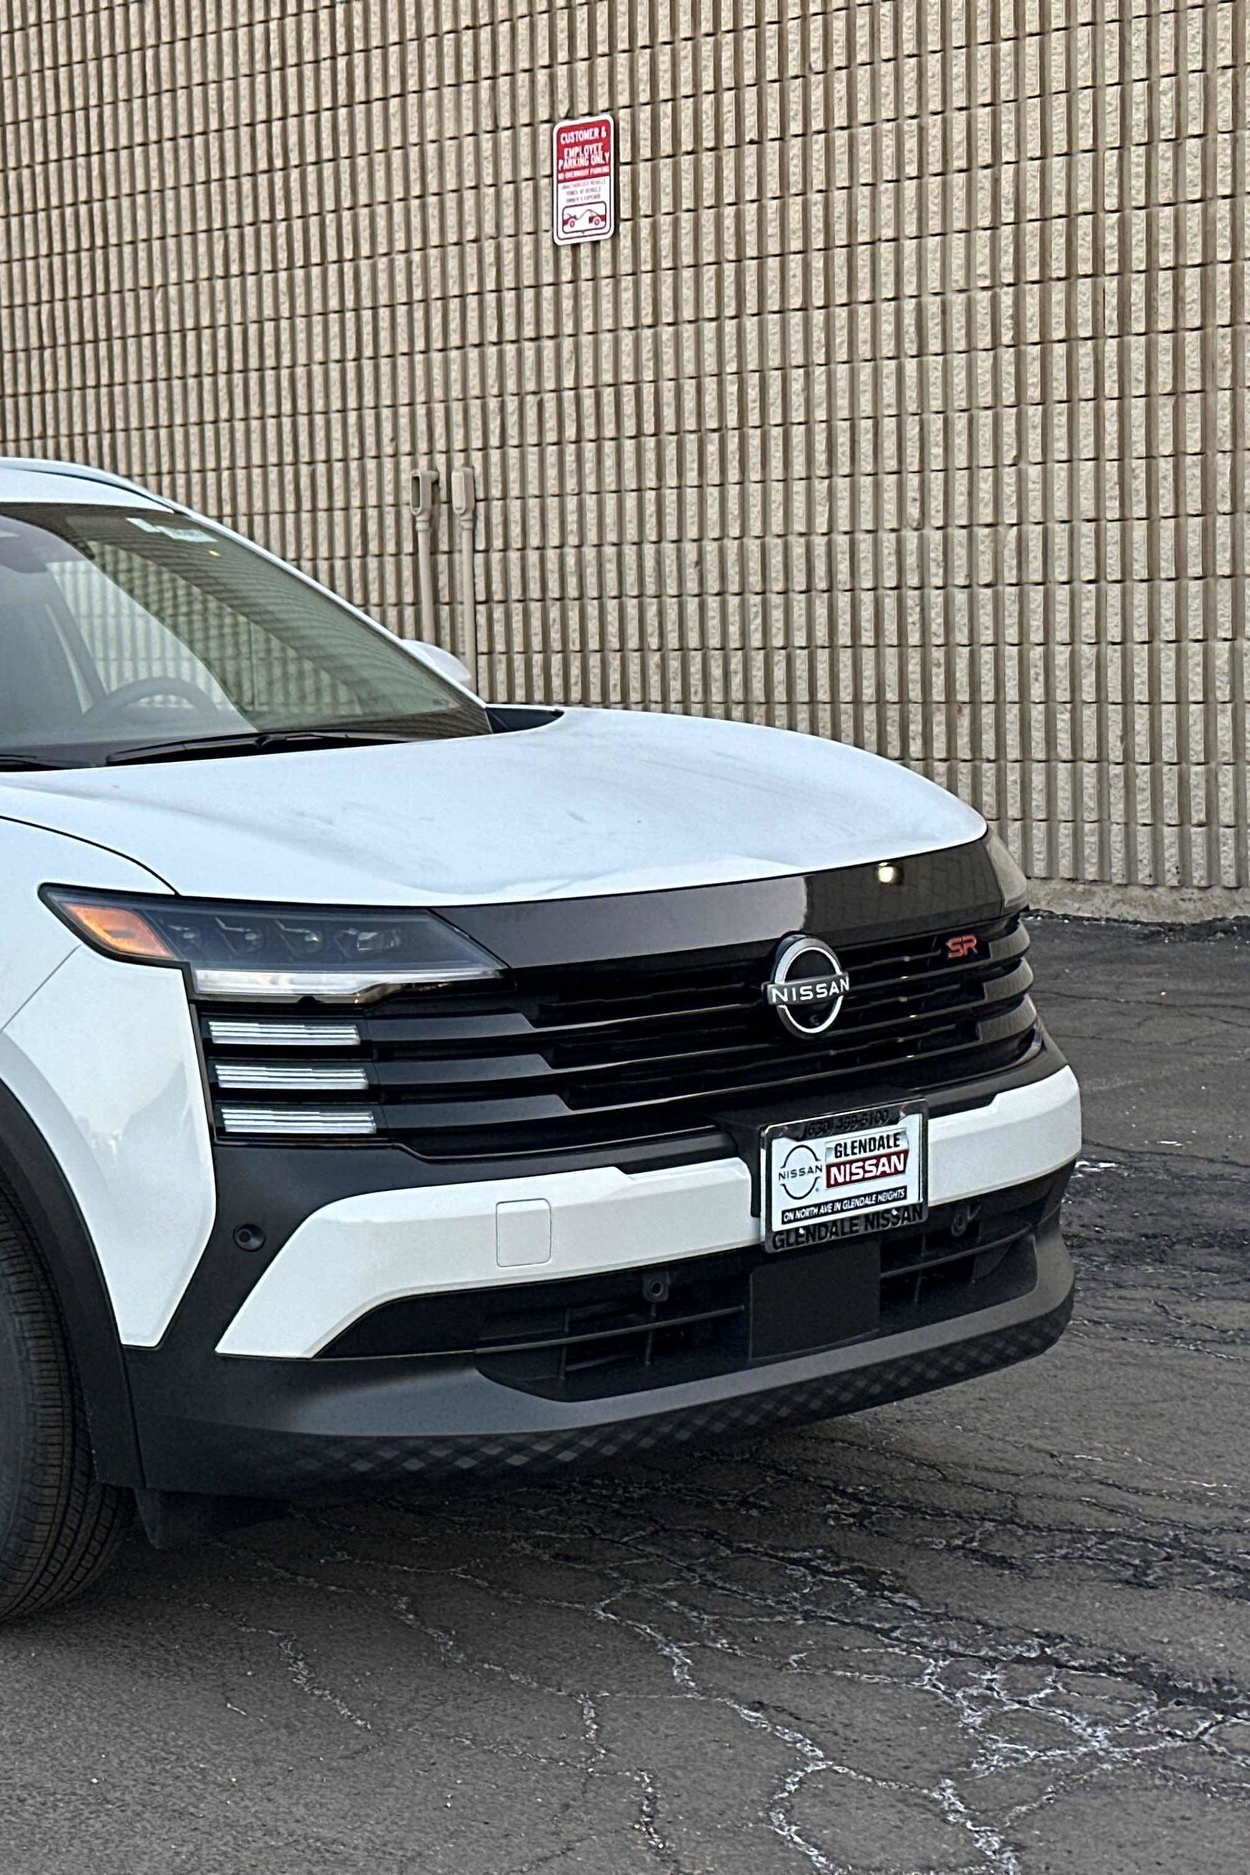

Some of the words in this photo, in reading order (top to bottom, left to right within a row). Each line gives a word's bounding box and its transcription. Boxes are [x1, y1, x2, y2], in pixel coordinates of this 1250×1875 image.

[560, 128, 599, 145] CUSTOMER
[601, 126, 607, 138] &
[558, 155, 589, 171] PARKING
[591, 152, 610, 165] ONLY
[564, 142, 603, 159] EMPLOYEE
[947, 934, 978, 959] SR
[771, 976, 850, 1005] NISSAN
[834, 1131, 901, 1158] GLENDALE
[778, 1164, 823, 1181] NISSAN
[830, 1153, 905, 1185] NISSAN
[783, 1210, 794, 1222] ON
[795, 1206, 819, 1219] NORTH
[819, 1203, 833, 1214] AVE
[834, 1202, 841, 1212] IN
[842, 1194, 877, 1210] GLENDALE
[877, 1188, 905, 1202] HEIGHTS
[772, 1218, 860, 1251] GLENDALE
[864, 1205, 923, 1232] NISSAN
